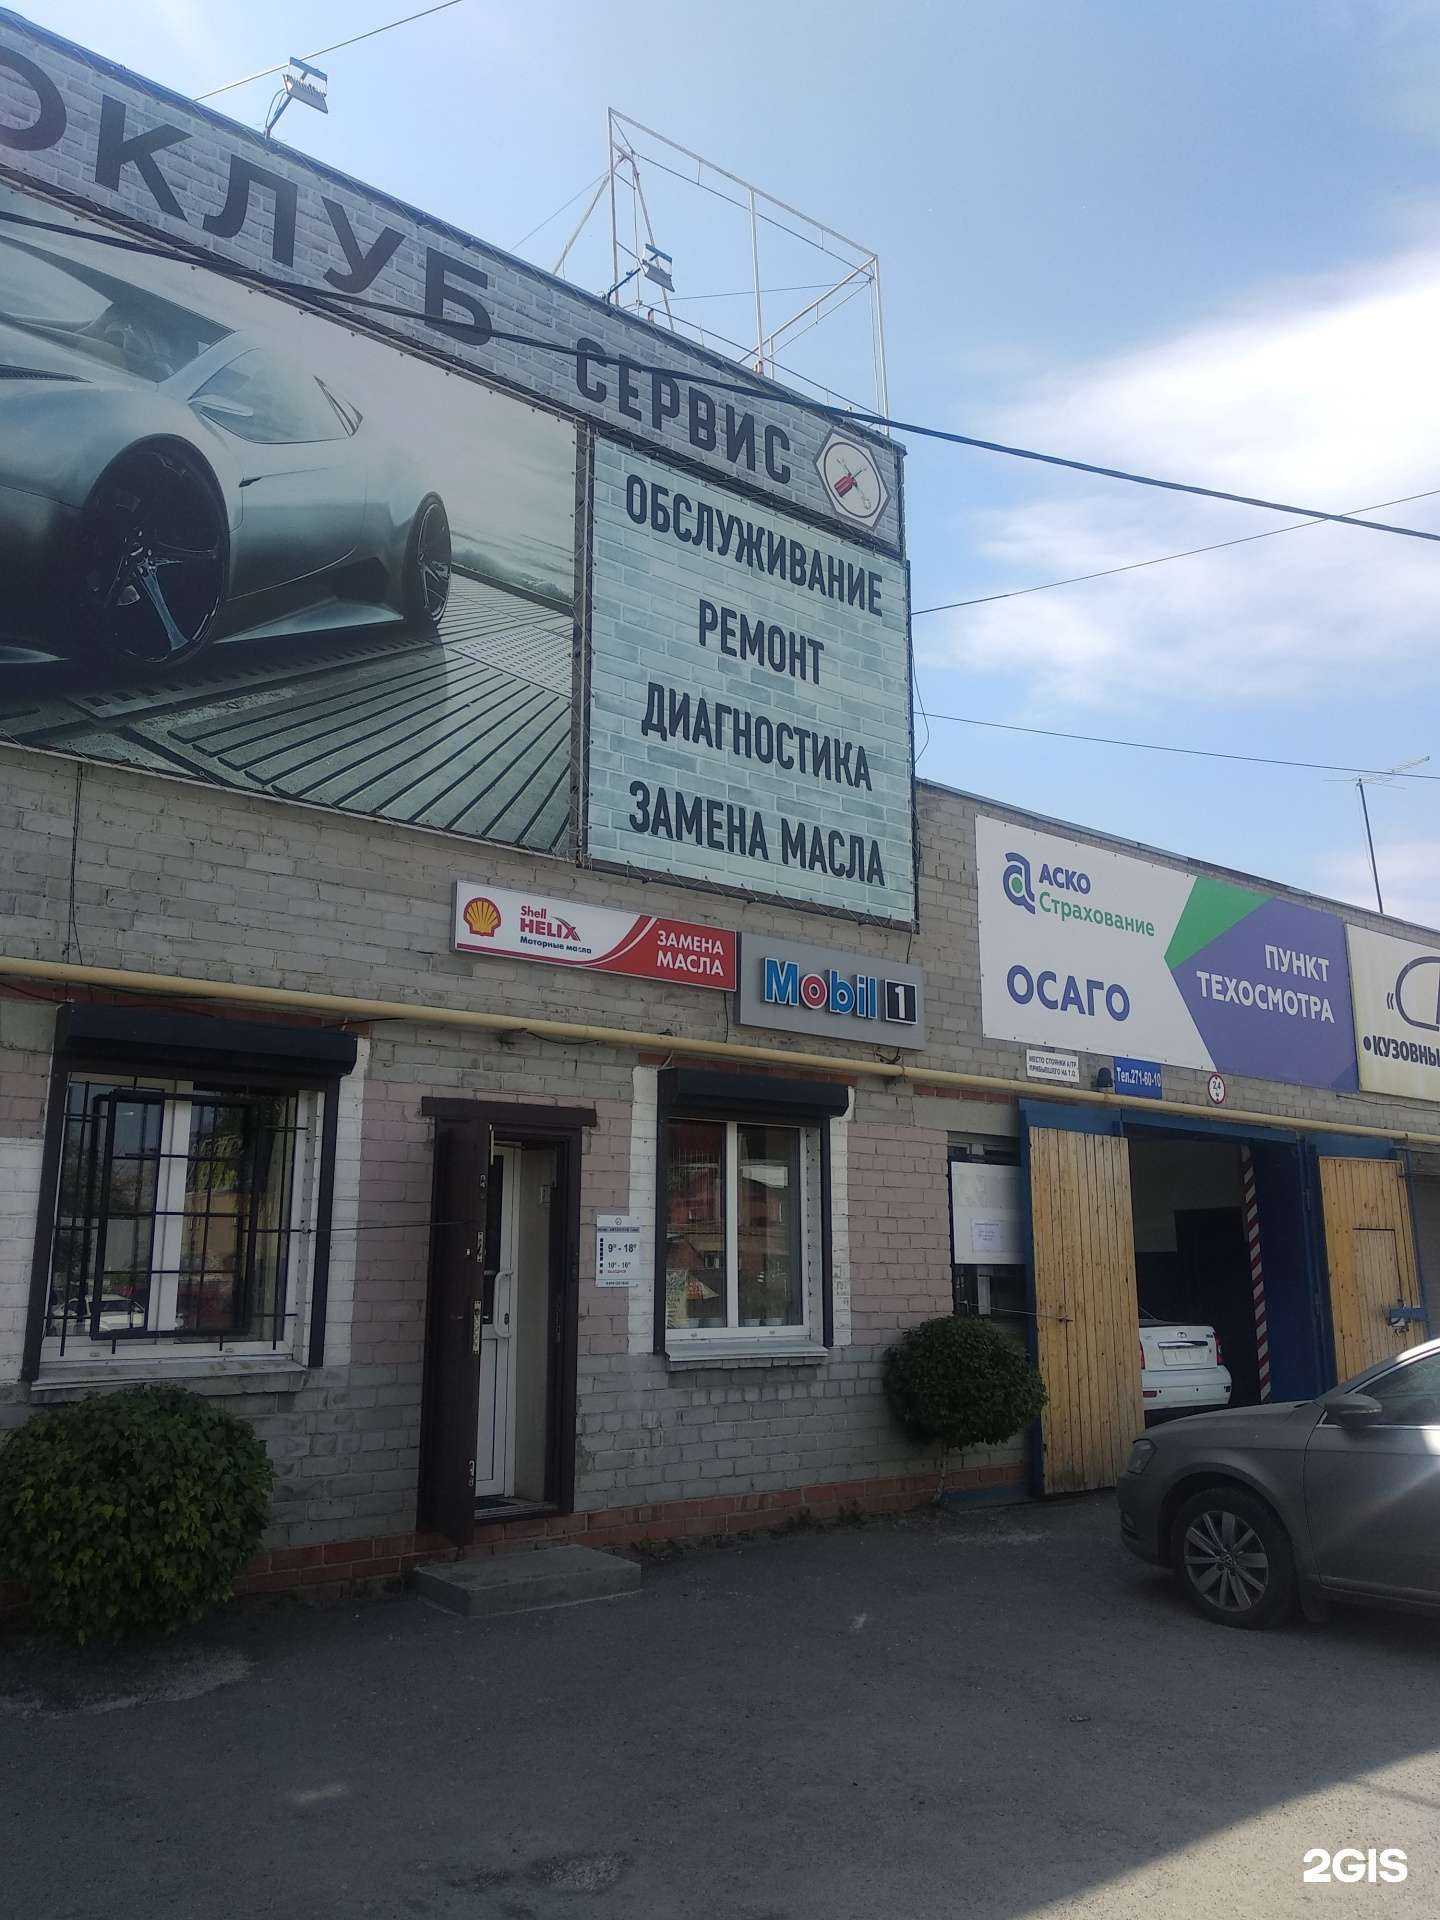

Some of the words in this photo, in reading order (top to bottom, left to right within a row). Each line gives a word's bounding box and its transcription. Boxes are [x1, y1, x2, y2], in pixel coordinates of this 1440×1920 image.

[576, 337, 791, 484] СЕРВИС
[626, 474, 883, 618] ОБСЛУЖИВАНИЕ
[699, 599, 824, 685] РЕМОНТ
[641, 681, 872, 792] ДИАГНОСТИКА
[629, 781, 769, 860] ЗАМЕНА
[781, 817, 886, 886] МАСЛА
[1039, 863, 1091, 894] АСКО
[520, 905, 547, 919] Shell
[520, 917, 580, 942] HELIX
[1039, 891, 1155, 936] Страхование
[520, 935, 565, 950] Моторные
[565, 944, 592, 954] масла
[656, 950, 725, 977] МАСЛА
[657, 930, 724, 956] ЗАМЕНА
[1265, 944, 1330, 982] ПУНКТ
[763, 957, 878, 1019] Mobil
[1006, 964, 1131, 1022] ОСАГО
[1196, 970, 1335, 1024] ТЕХОСМОТРА
